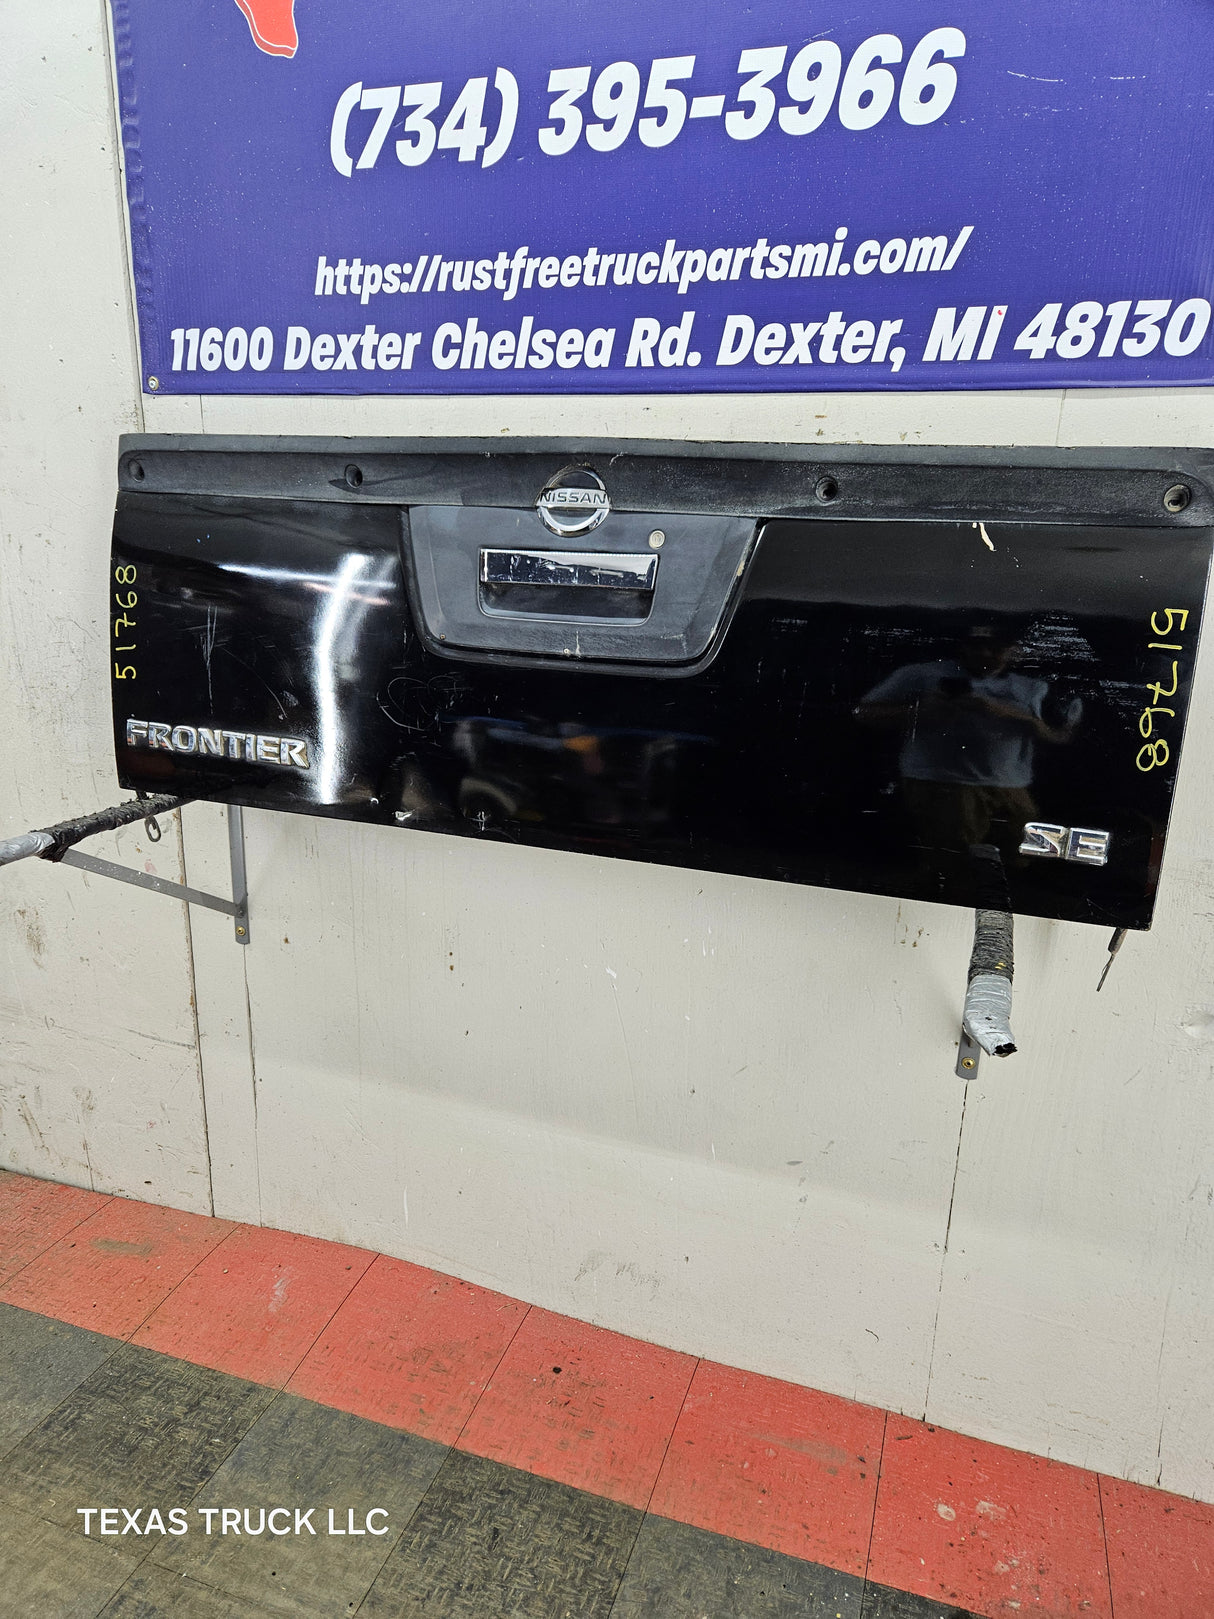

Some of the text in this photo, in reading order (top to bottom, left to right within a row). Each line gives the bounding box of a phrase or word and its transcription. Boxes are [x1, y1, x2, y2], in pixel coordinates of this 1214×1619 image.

[330, 27, 967, 177] (734) 395-3966
[315, 226, 974, 304] https://rustfreetruckpartsmi.com/
[170, 298, 1211, 372] 11600 Dexter Chelsea Rd. Dexter, MI 48130
[539, 490, 608, 505] NISSAN
[115, 564, 138, 680] 51768
[126, 719, 310, 768] FRONTIER
[1019, 822, 1110, 865] SE
